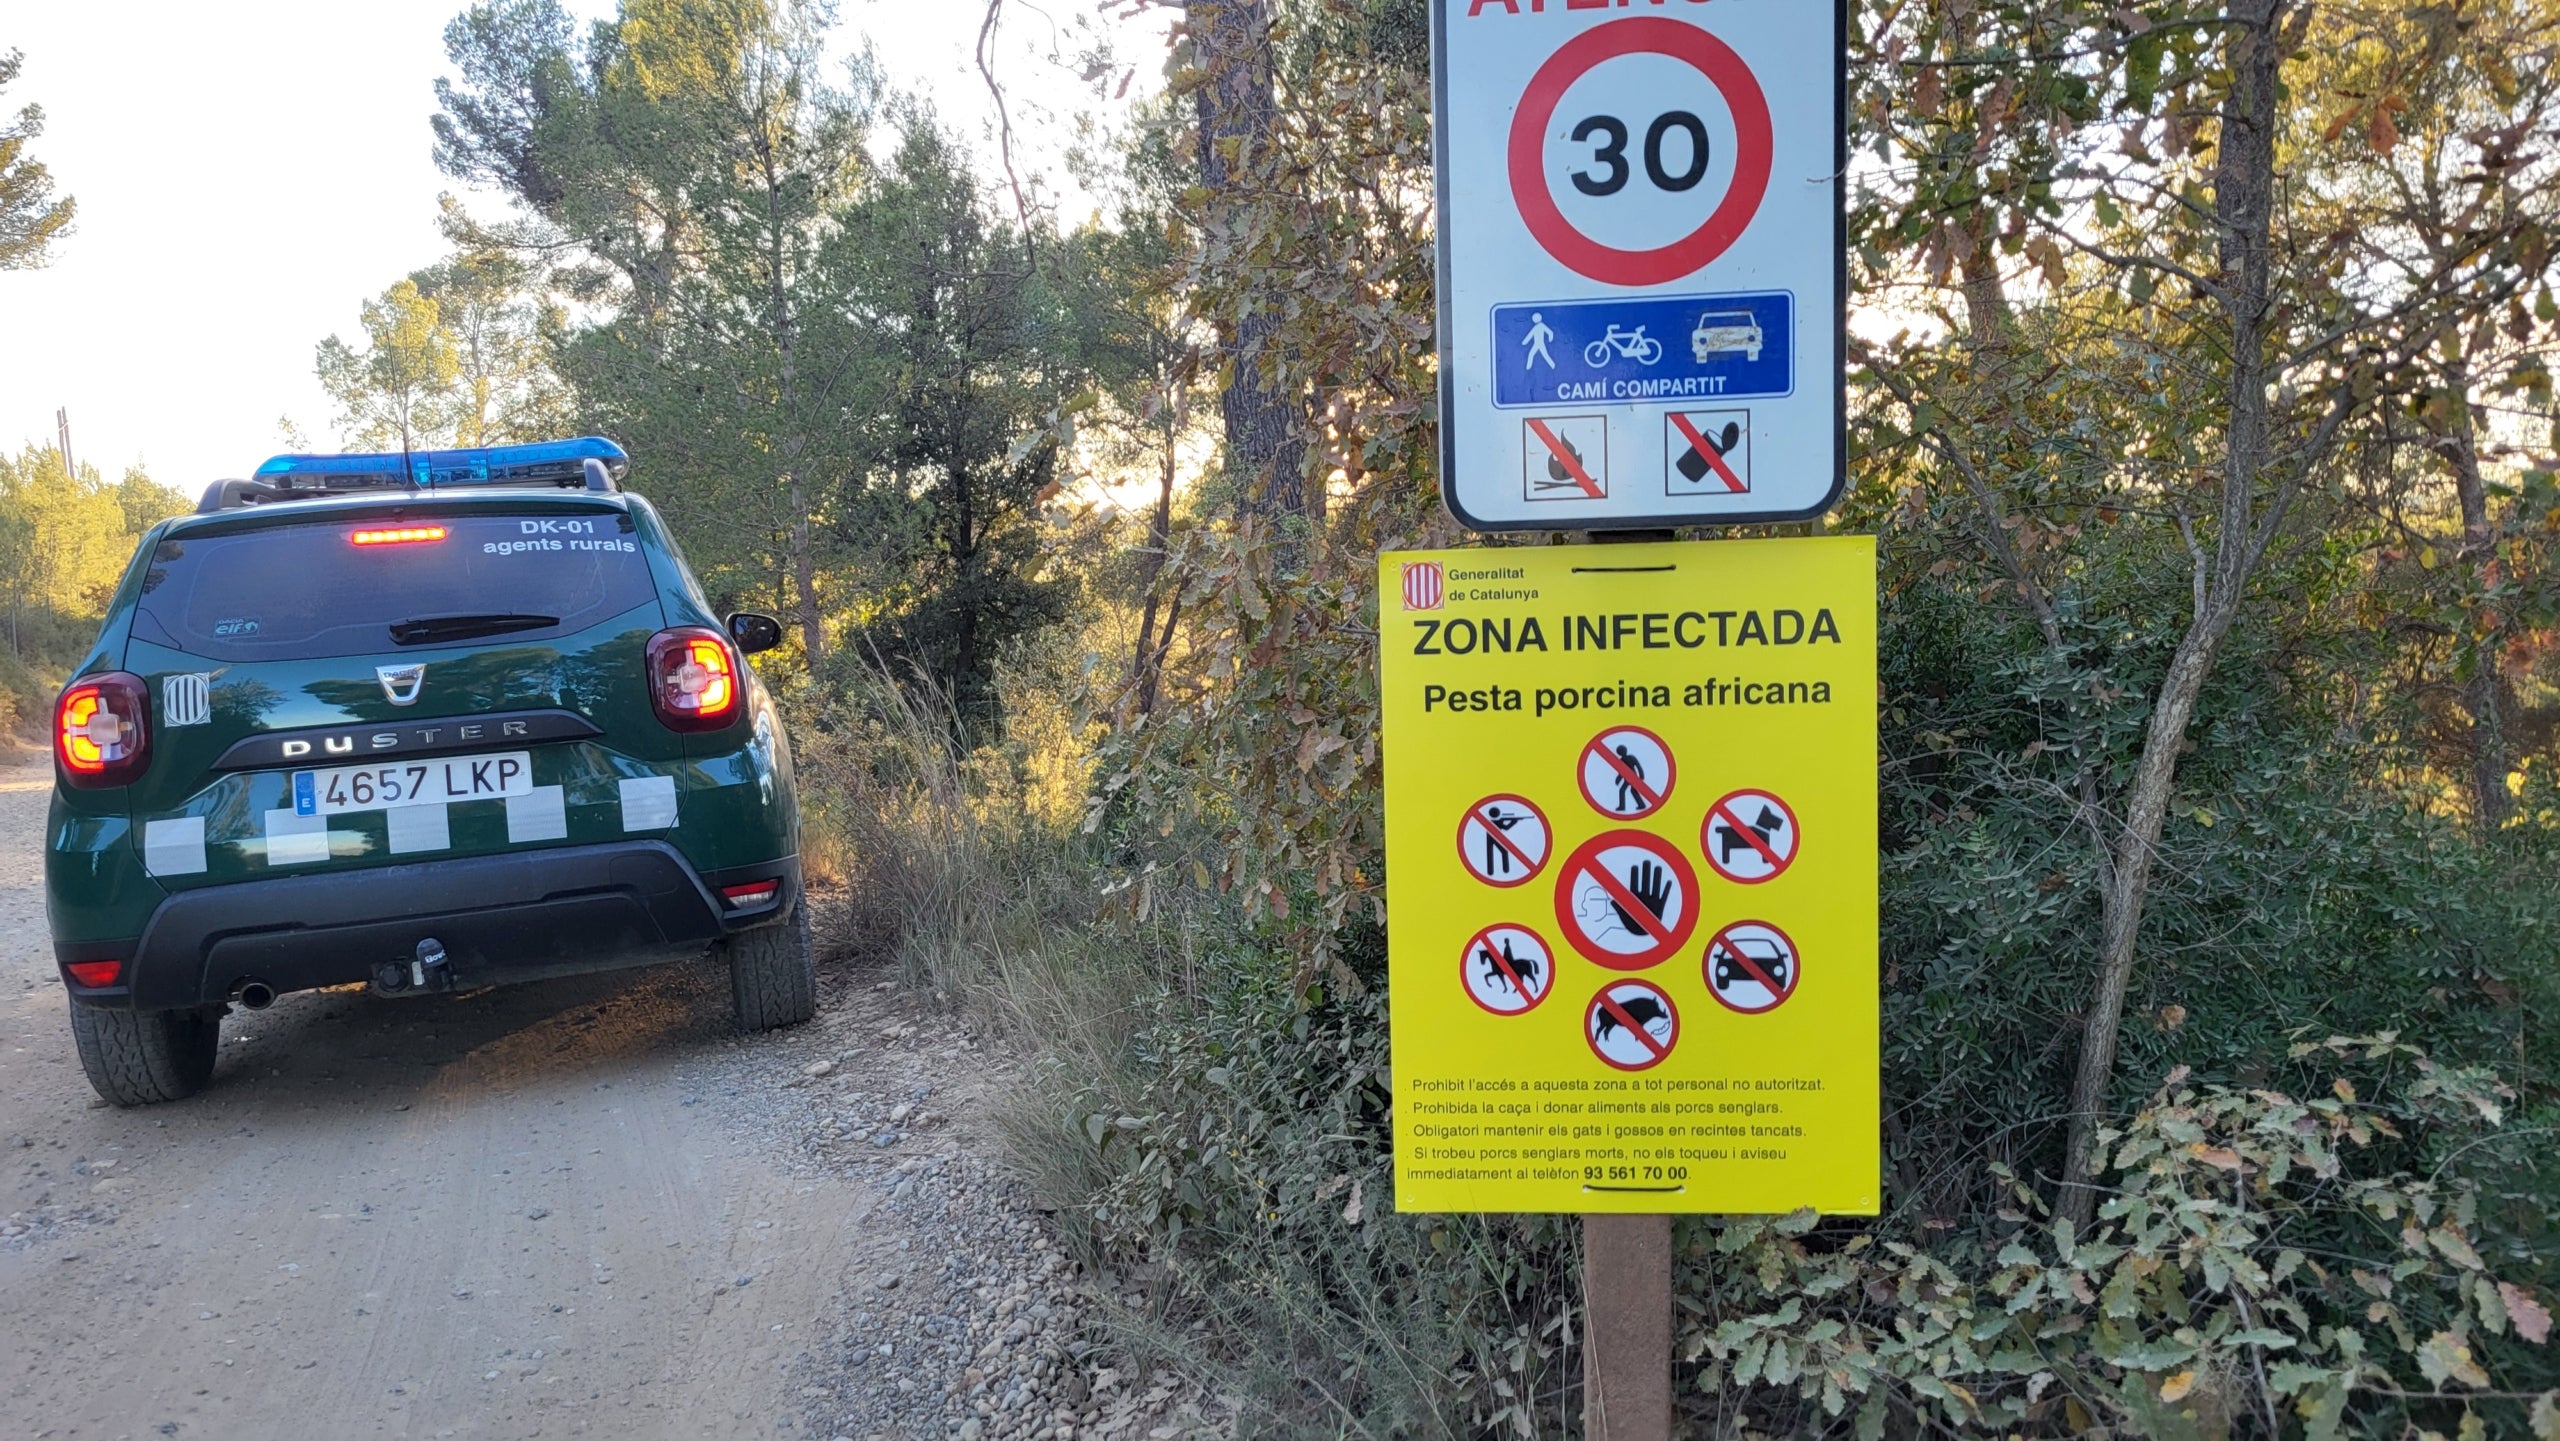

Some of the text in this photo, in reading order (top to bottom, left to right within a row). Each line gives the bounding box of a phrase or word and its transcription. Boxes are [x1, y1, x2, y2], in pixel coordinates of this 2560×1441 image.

[1570, 110, 1710, 197] 30
[1557, 375, 1728, 400] CAMÍ COMPARTIT
[520, 520, 594, 534] DK-01
[483, 538, 636, 556] agents rurals
[1448, 567, 1525, 581] Generalitat
[1448, 587, 1539, 602] de Catalunya
[215, 623, 244, 634] elf
[1413, 608, 1842, 656] ZONA INFECTADA
[1423, 677, 1832, 717] Pesta porcina africana
[282, 720, 529, 758] DUSTER
[325, 758, 521, 807] 4657 LKP
[301, 798, 311, 808] E
[1413, 1079, 1465, 1091] Prohibit
[1520, 1081, 1530, 1091] a
[1533, 1080, 1589, 1095] aquesta
[1593, 1081, 1628, 1091] zona
[1632, 1081, 1641, 1091] a
[1645, 1079, 1663, 1091] tot
[1667, 1078, 1728, 1094] personal
[1732, 1080, 1750, 1091] no
[1755, 1078, 1826, 1091] autoritzat.
[1413, 1101, 1478, 1114] Prohibida
[1482, 1101, 1494, 1114] la
[1498, 1103, 1531, 1116] caça
[1543, 1101, 1583, 1114] donar
[1588, 1101, 1646, 1114] aliments
[1650, 1101, 1671, 1113] als
[1675, 1103, 1714, 1116] porcs
[1718, 1101, 1784, 1116] senglars.
[1413, 1123, 1479, 1139] Obligatori
[1484, 1124, 1544, 1136] mantenir
[1548, 1124, 1568, 1136] els
[1572, 1125, 1602, 1139] gats
[1614, 1126, 1664, 1139] gossos
[1669, 1126, 1686, 1136] en
[1691, 1124, 1746, 1136] recintes
[1751, 1124, 1807, 1136] tancats.
[1414, 1147, 1428, 1159] Si
[1432, 1147, 1476, 1159] trobeu
[1480, 1149, 1518, 1161] porcs
[1522, 1147, 1581, 1161] senglars
[1585, 1148, 1628, 1160] morts,
[1633, 1149, 1651, 1159] no
[1655, 1147, 1675, 1159] els
[1680, 1148, 1728, 1161] toqueu
[1740, 1147, 1787, 1159] aviseu
[1407, 1167, 1513, 1180] immediatament
[1516, 1167, 1528, 1180] al
[1533, 1167, 1579, 1180] telèfon
[1583, 1166, 1603, 1180] 93
[1608, 1166, 1636, 1180] 561
[1643, 1166, 1663, 1180] 70
